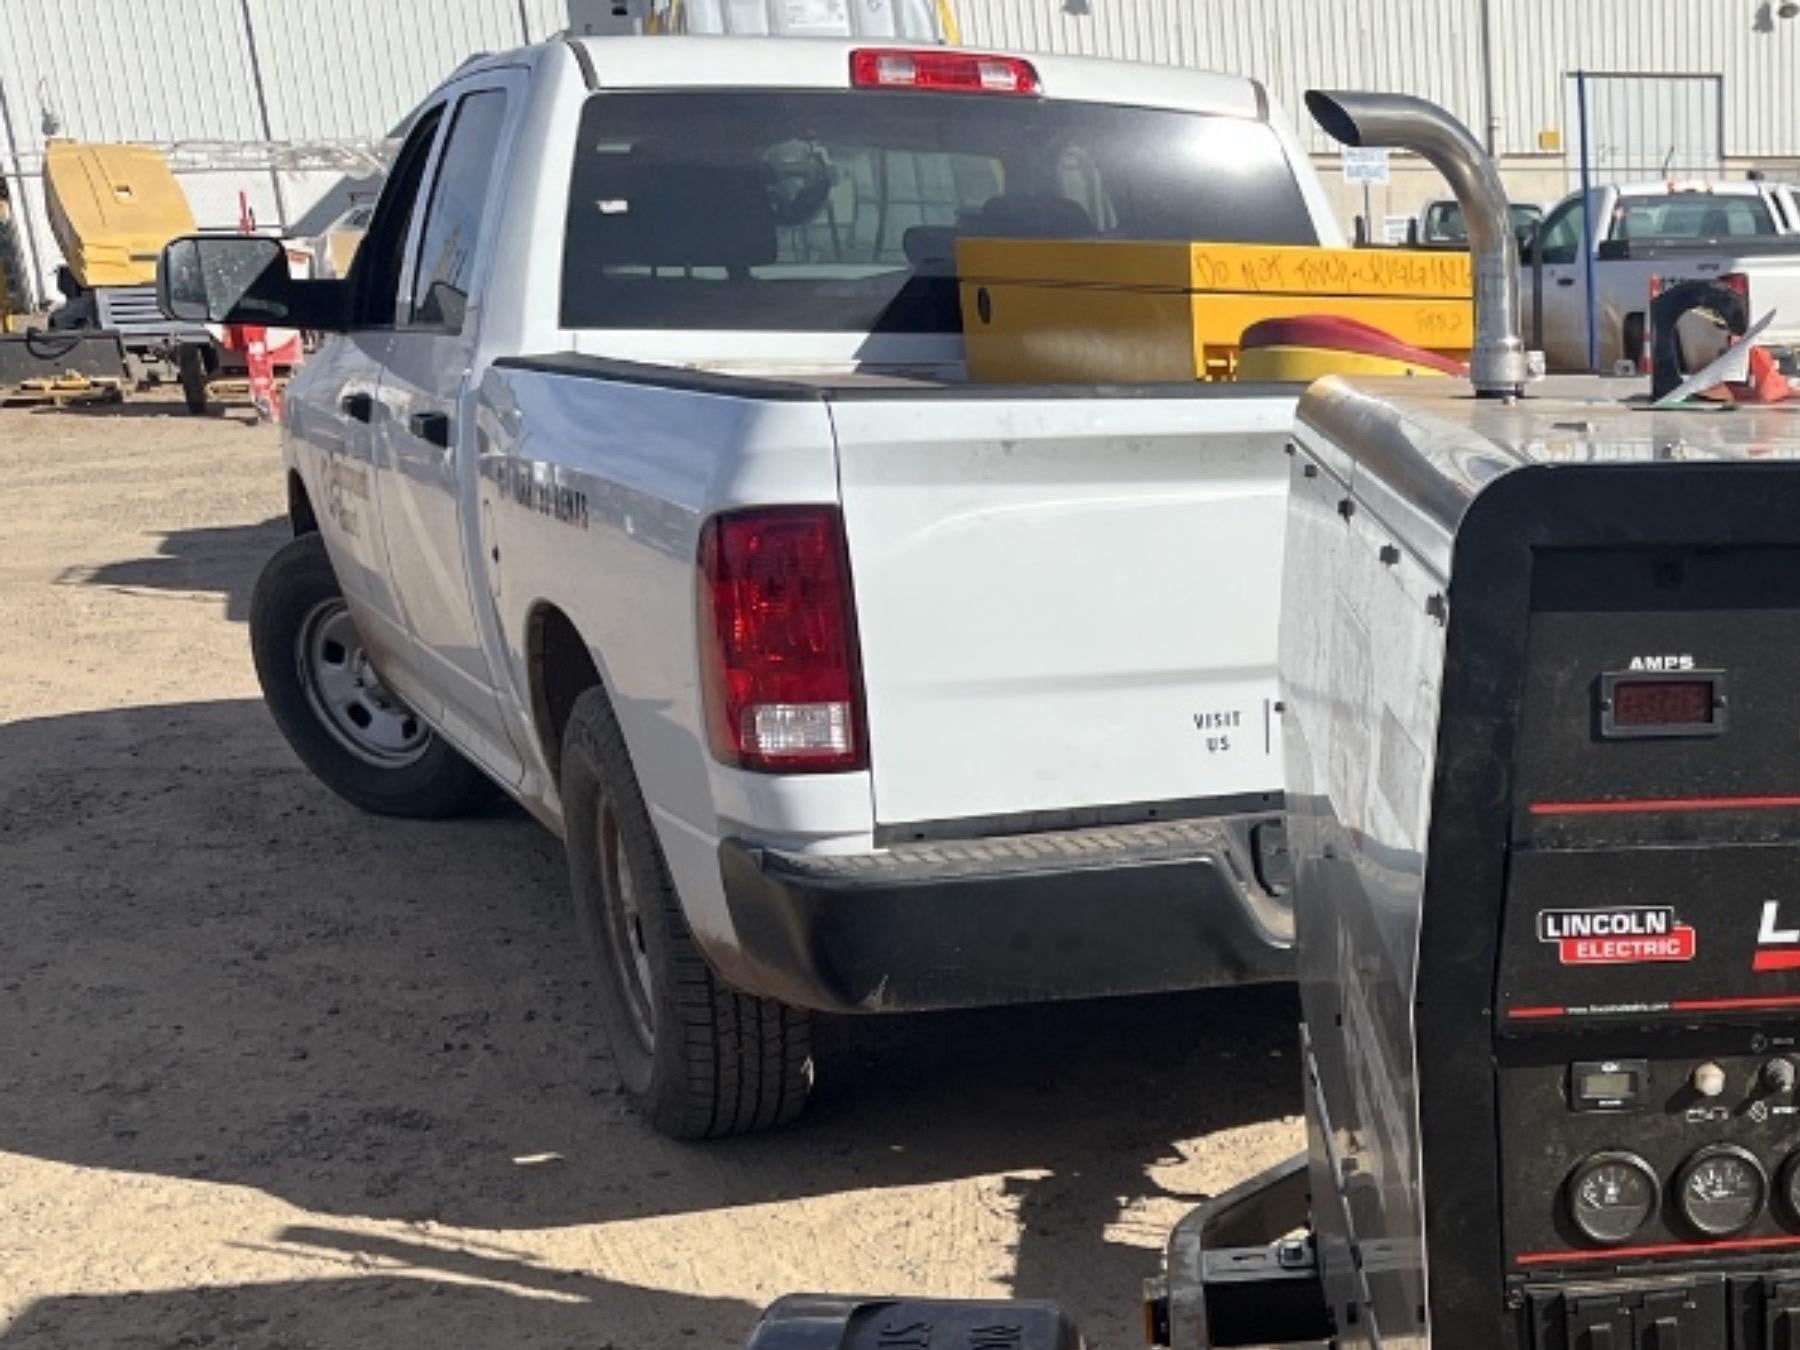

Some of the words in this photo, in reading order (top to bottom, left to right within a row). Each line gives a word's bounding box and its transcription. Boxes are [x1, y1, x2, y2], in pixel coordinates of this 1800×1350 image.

[1628, 655, 1697, 672] AMPS
[1193, 711, 1241, 730] VISIT
[1205, 735, 1230, 753] US
[1546, 911, 1667, 938] LINCOLN
[1576, 938, 1681, 959] ELECTRIC
